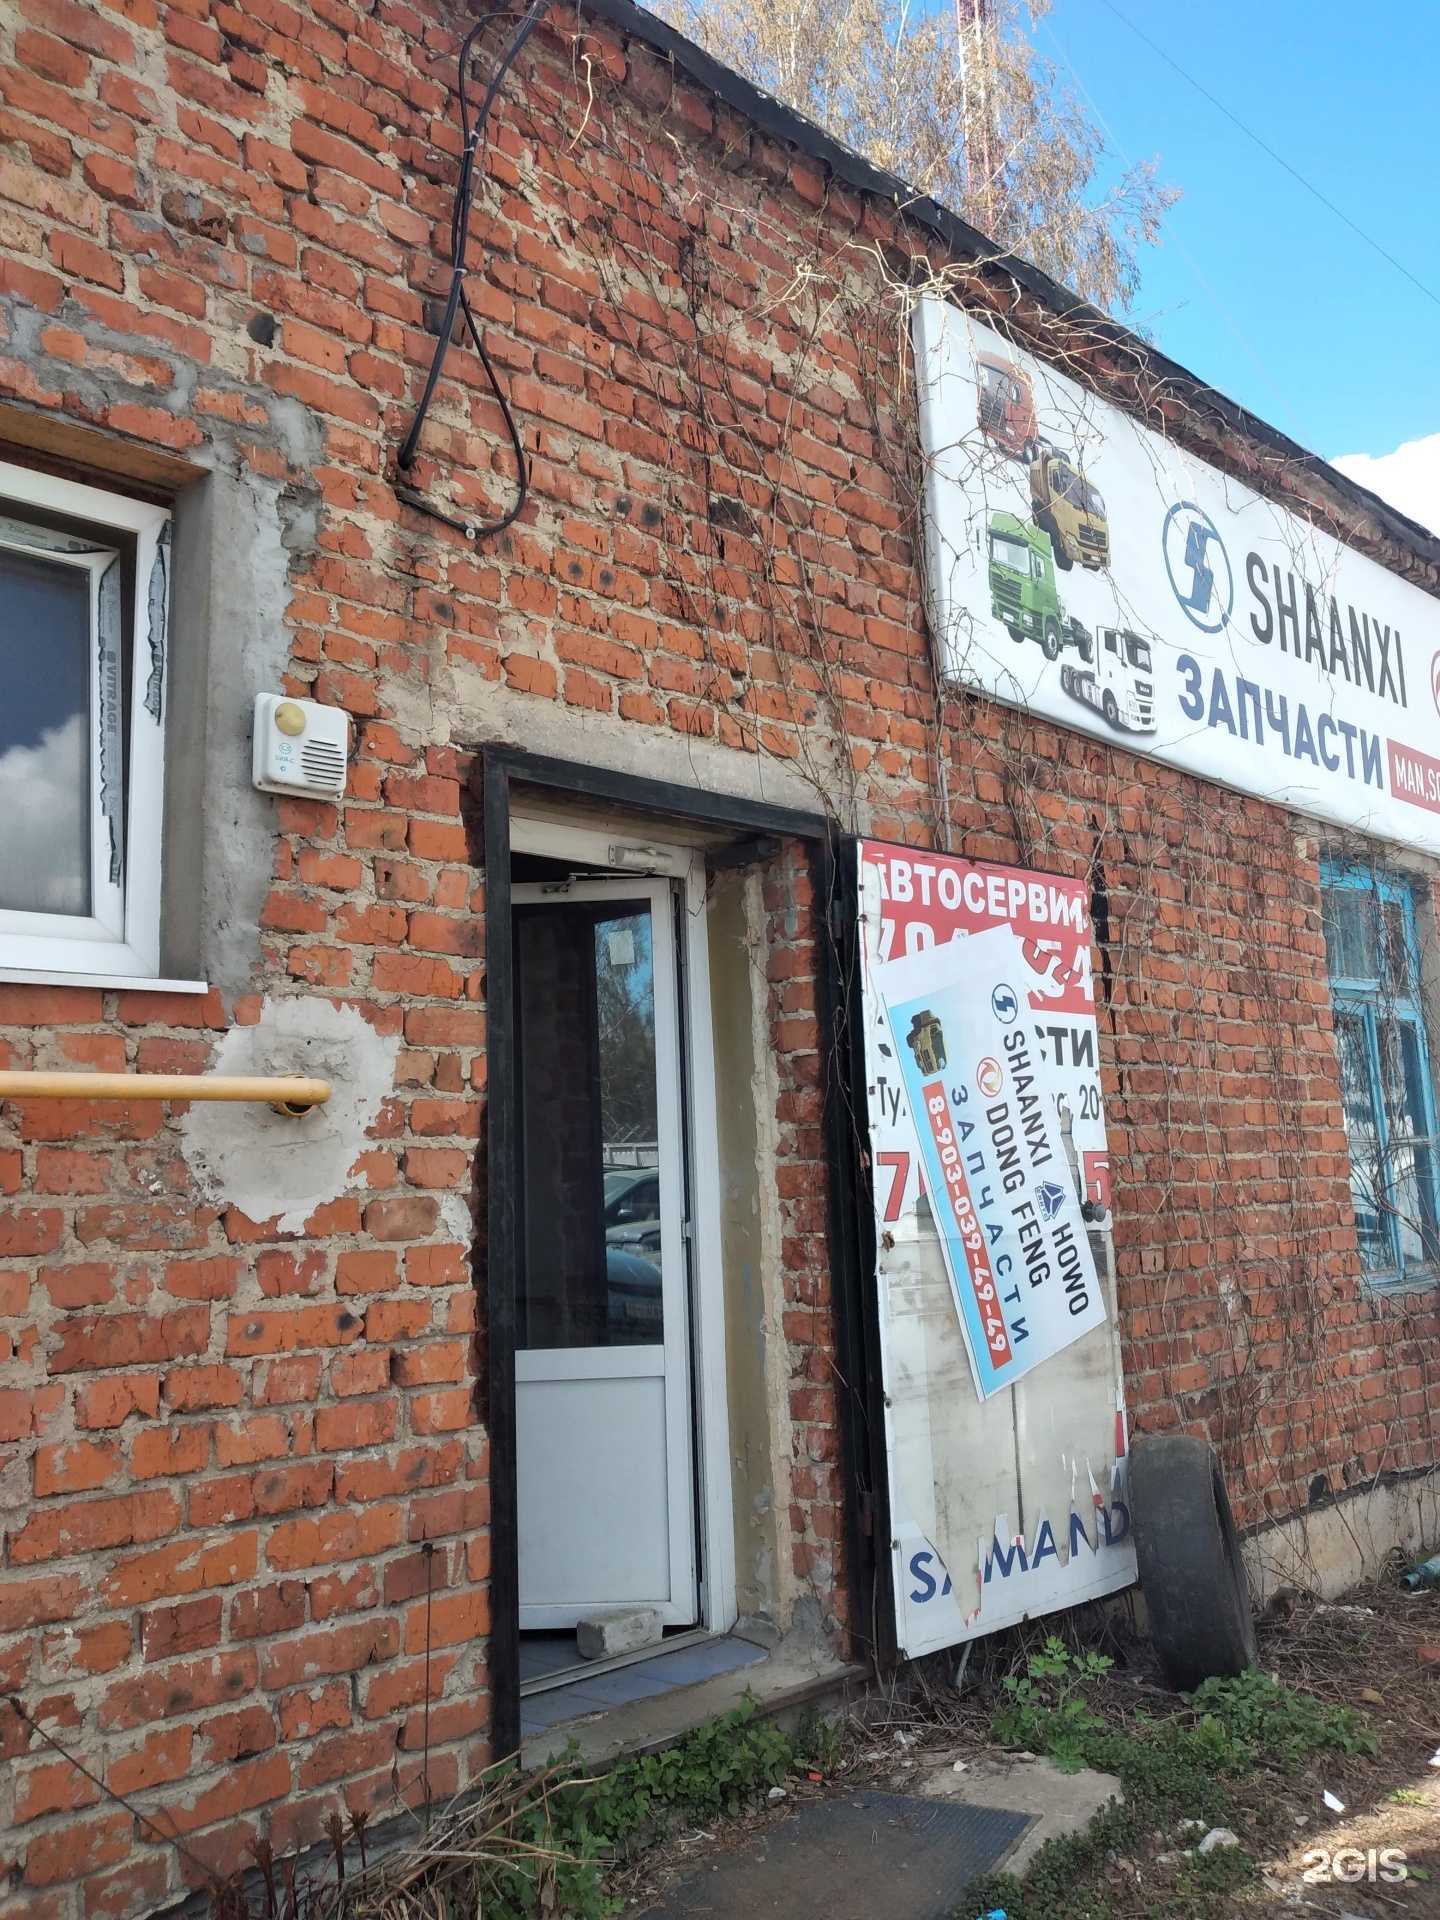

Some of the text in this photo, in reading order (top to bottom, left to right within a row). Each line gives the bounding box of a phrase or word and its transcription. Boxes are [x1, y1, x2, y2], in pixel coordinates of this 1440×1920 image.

[1246, 552, 1408, 708] SHAANXI
[1176, 654, 1384, 790] ЗАПЧАСТИ
[1003, 1030, 1052, 1168] SHAANXI
[928, 1094, 1006, 1353] 8-903-039-49-49
[952, 1085, 1029, 1343] ЗАПЧАСТИ
[986, 1102, 1050, 1288] DONG FENG
[1052, 1222, 1089, 1316] HOWO
